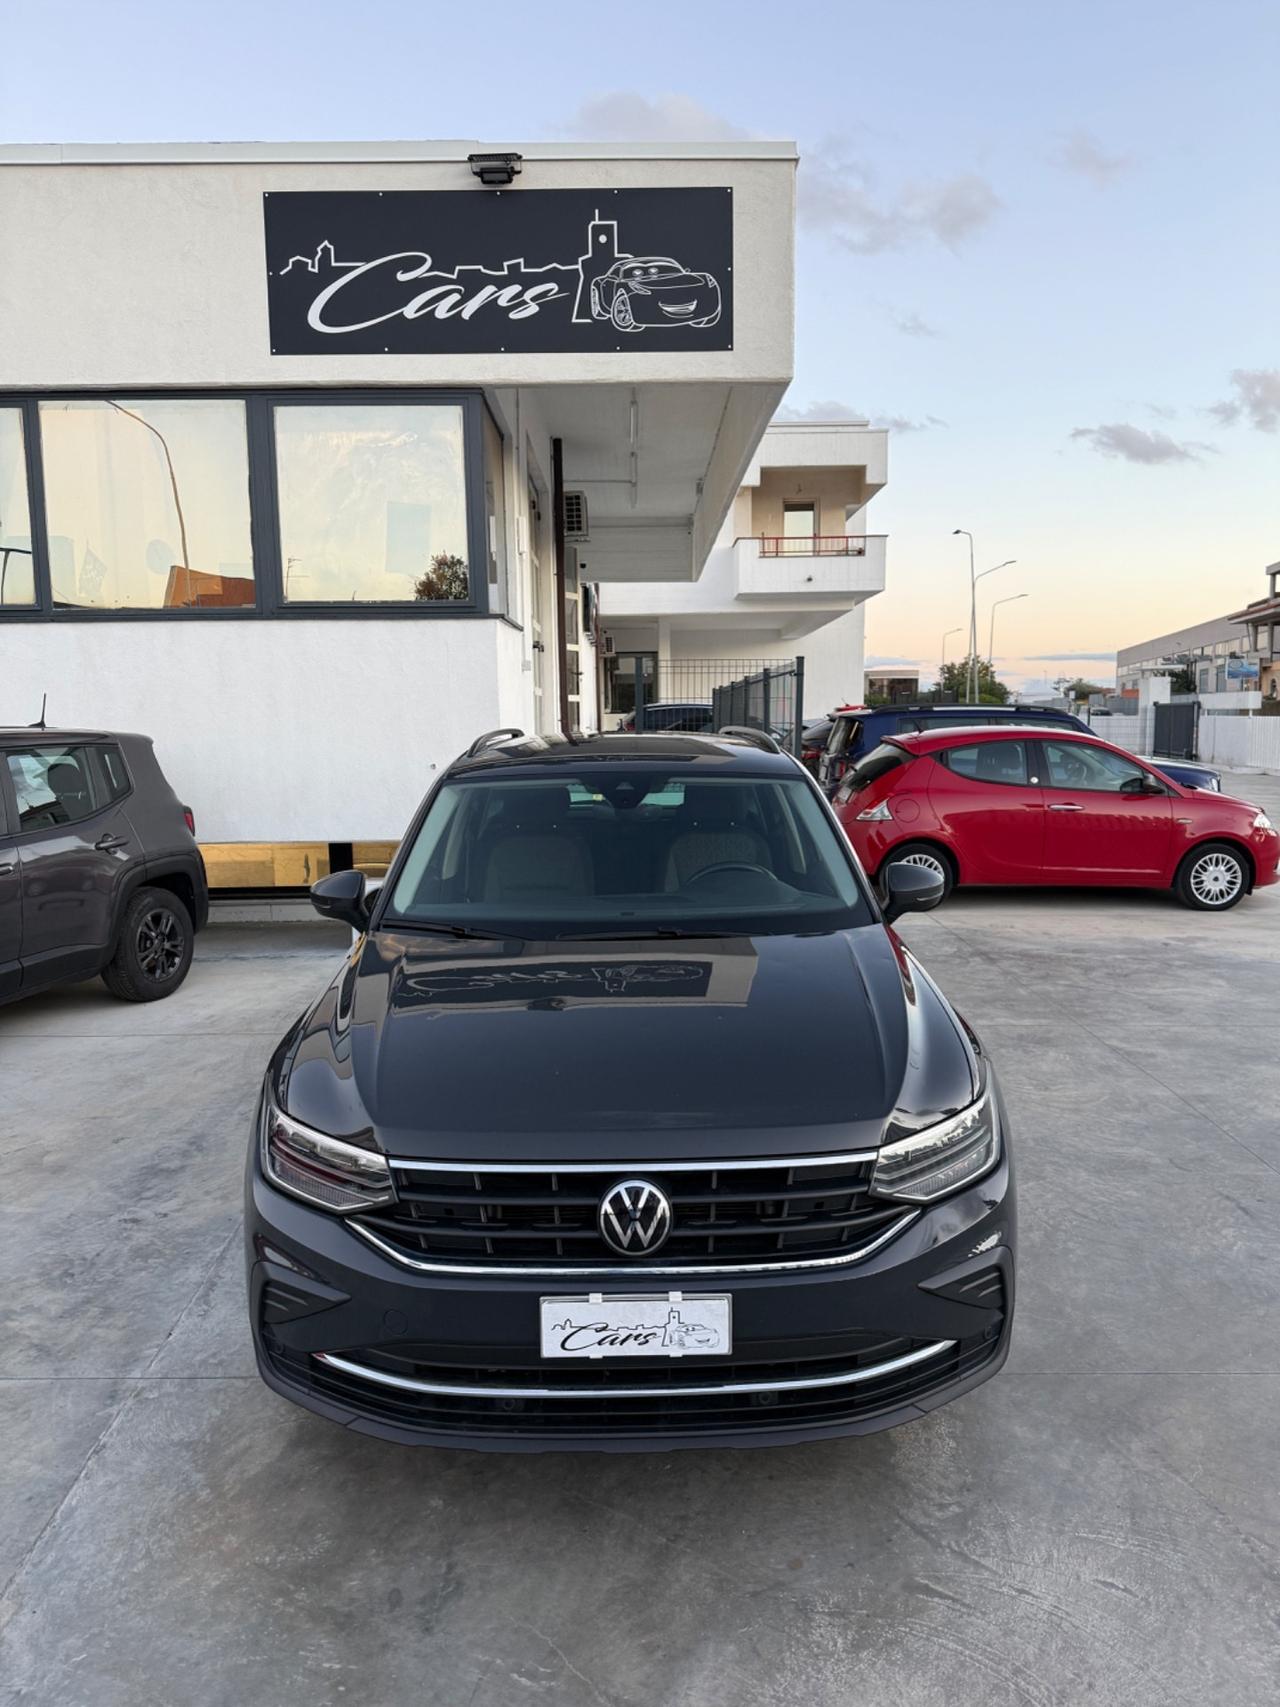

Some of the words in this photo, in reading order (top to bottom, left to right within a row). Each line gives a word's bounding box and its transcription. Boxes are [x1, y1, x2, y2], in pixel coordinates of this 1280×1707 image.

[307, 251, 570, 334] Cars
[602, 1182, 670, 1253] VW
[560, 1322, 661, 1351] Cars
